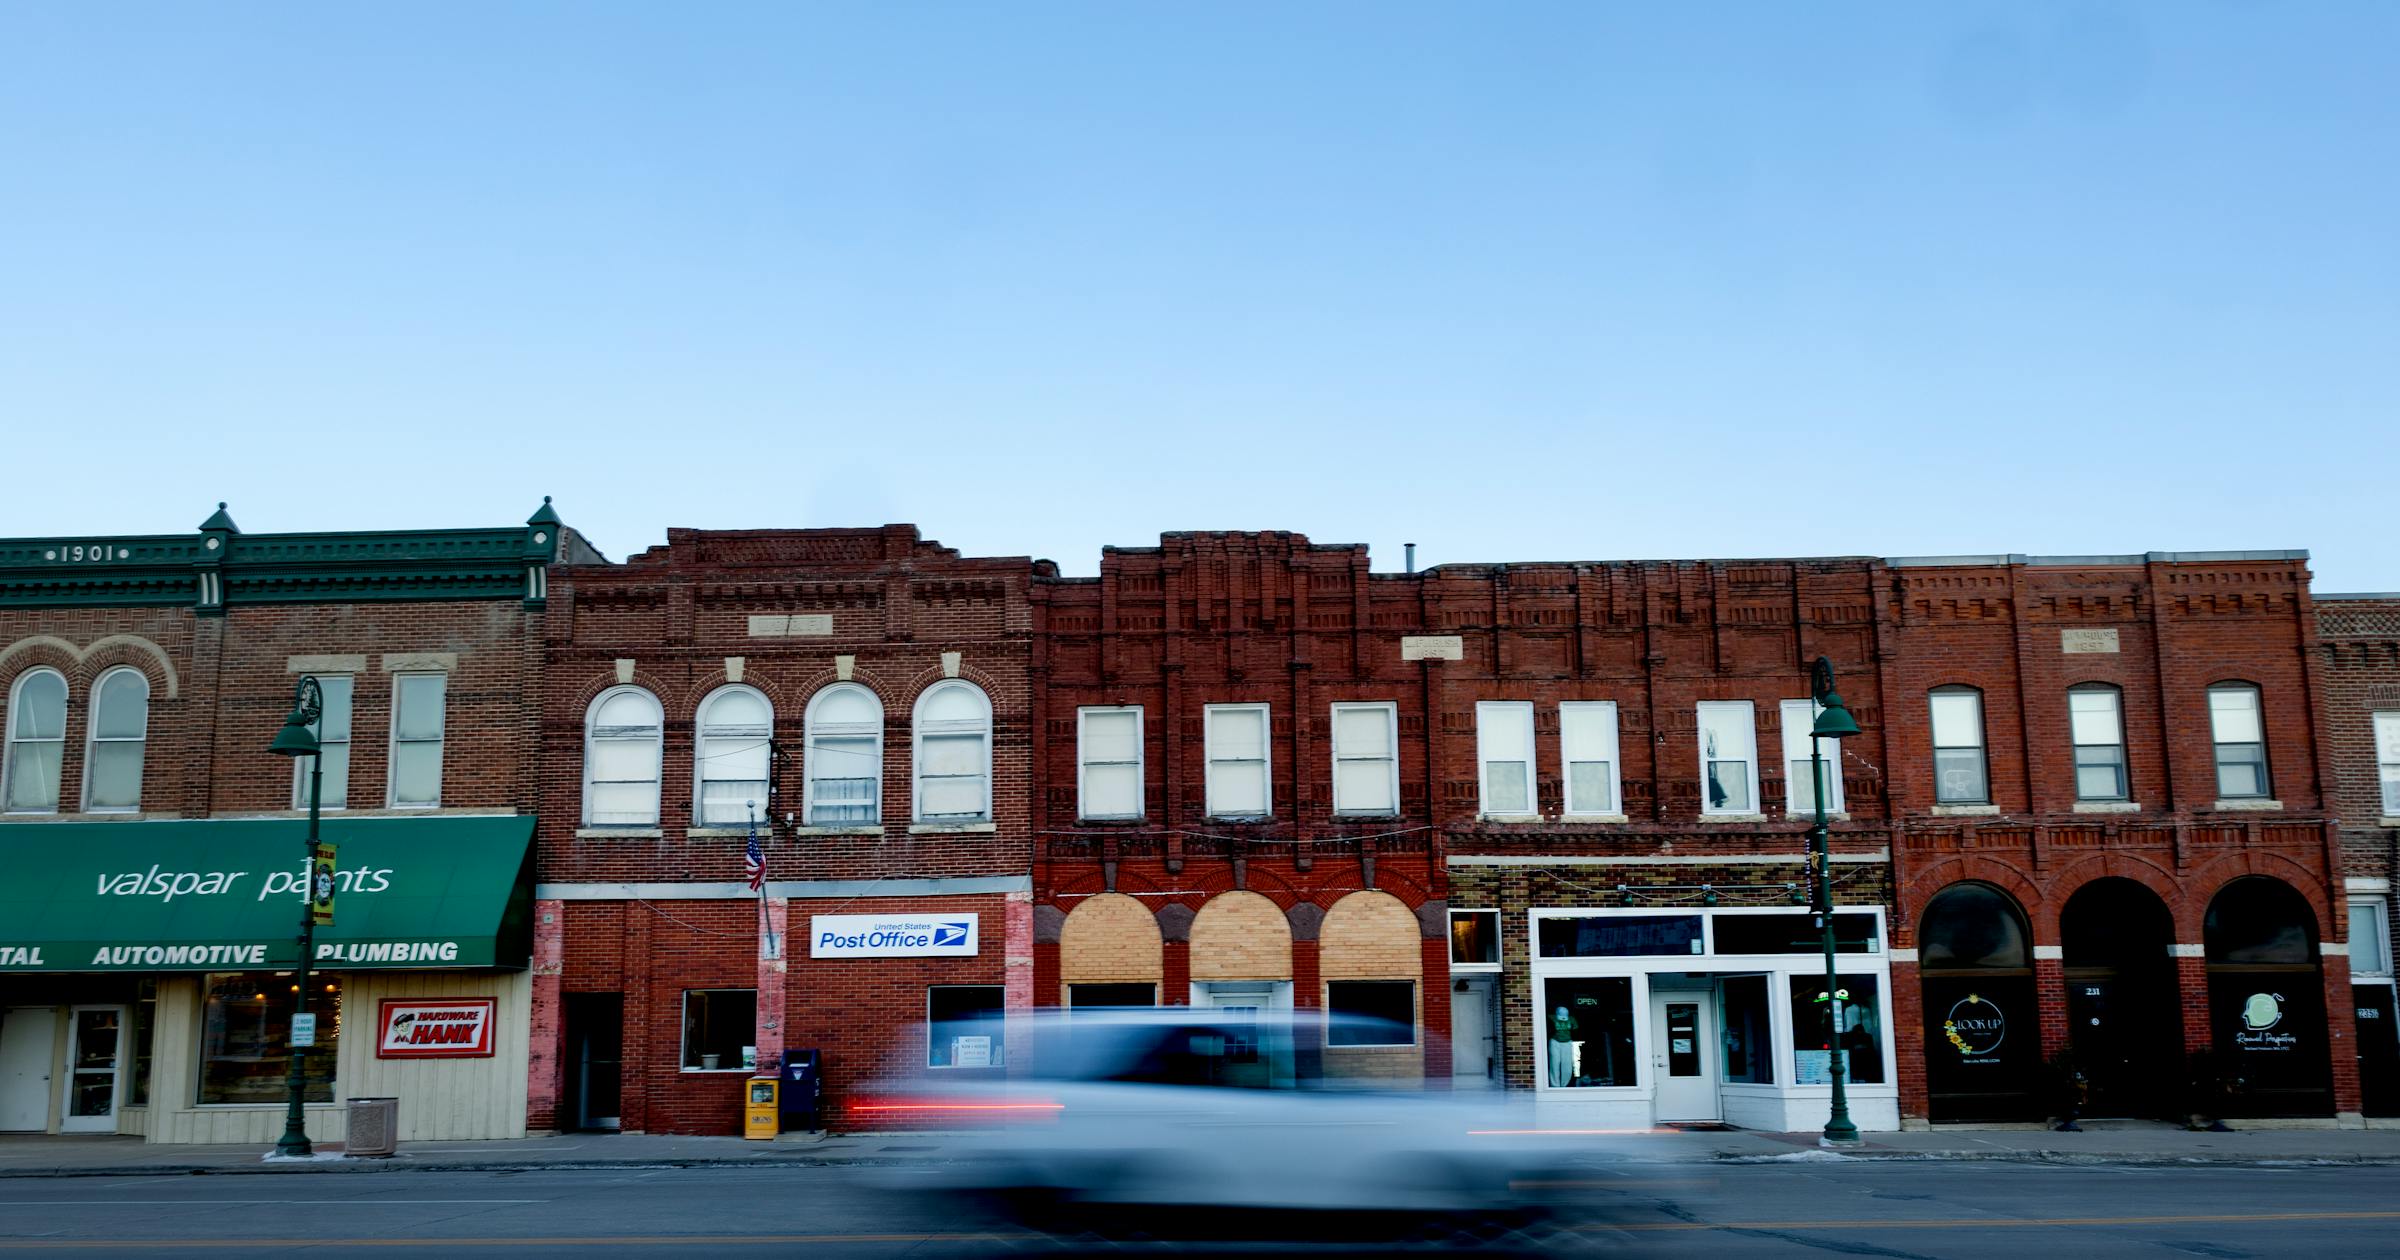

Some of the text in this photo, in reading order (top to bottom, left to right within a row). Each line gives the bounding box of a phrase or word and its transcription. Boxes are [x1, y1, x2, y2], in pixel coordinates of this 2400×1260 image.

[61, 545, 113, 562] 1901
[97, 864, 394, 903] valspar pants
[874, 923, 903, 931] United
[820, 932, 929, 948] Post Office
[0, 942, 459, 966] TAL AUTOMOTIVE PLUMBING
[2085, 987, 2100, 996] 231
[1577, 997, 1598, 1006] OPEN
[418, 1011, 480, 1021] HARDWARE
[1957, 1019, 2002, 1030] LOOK UP
[409, 1024, 480, 1044] HANK
